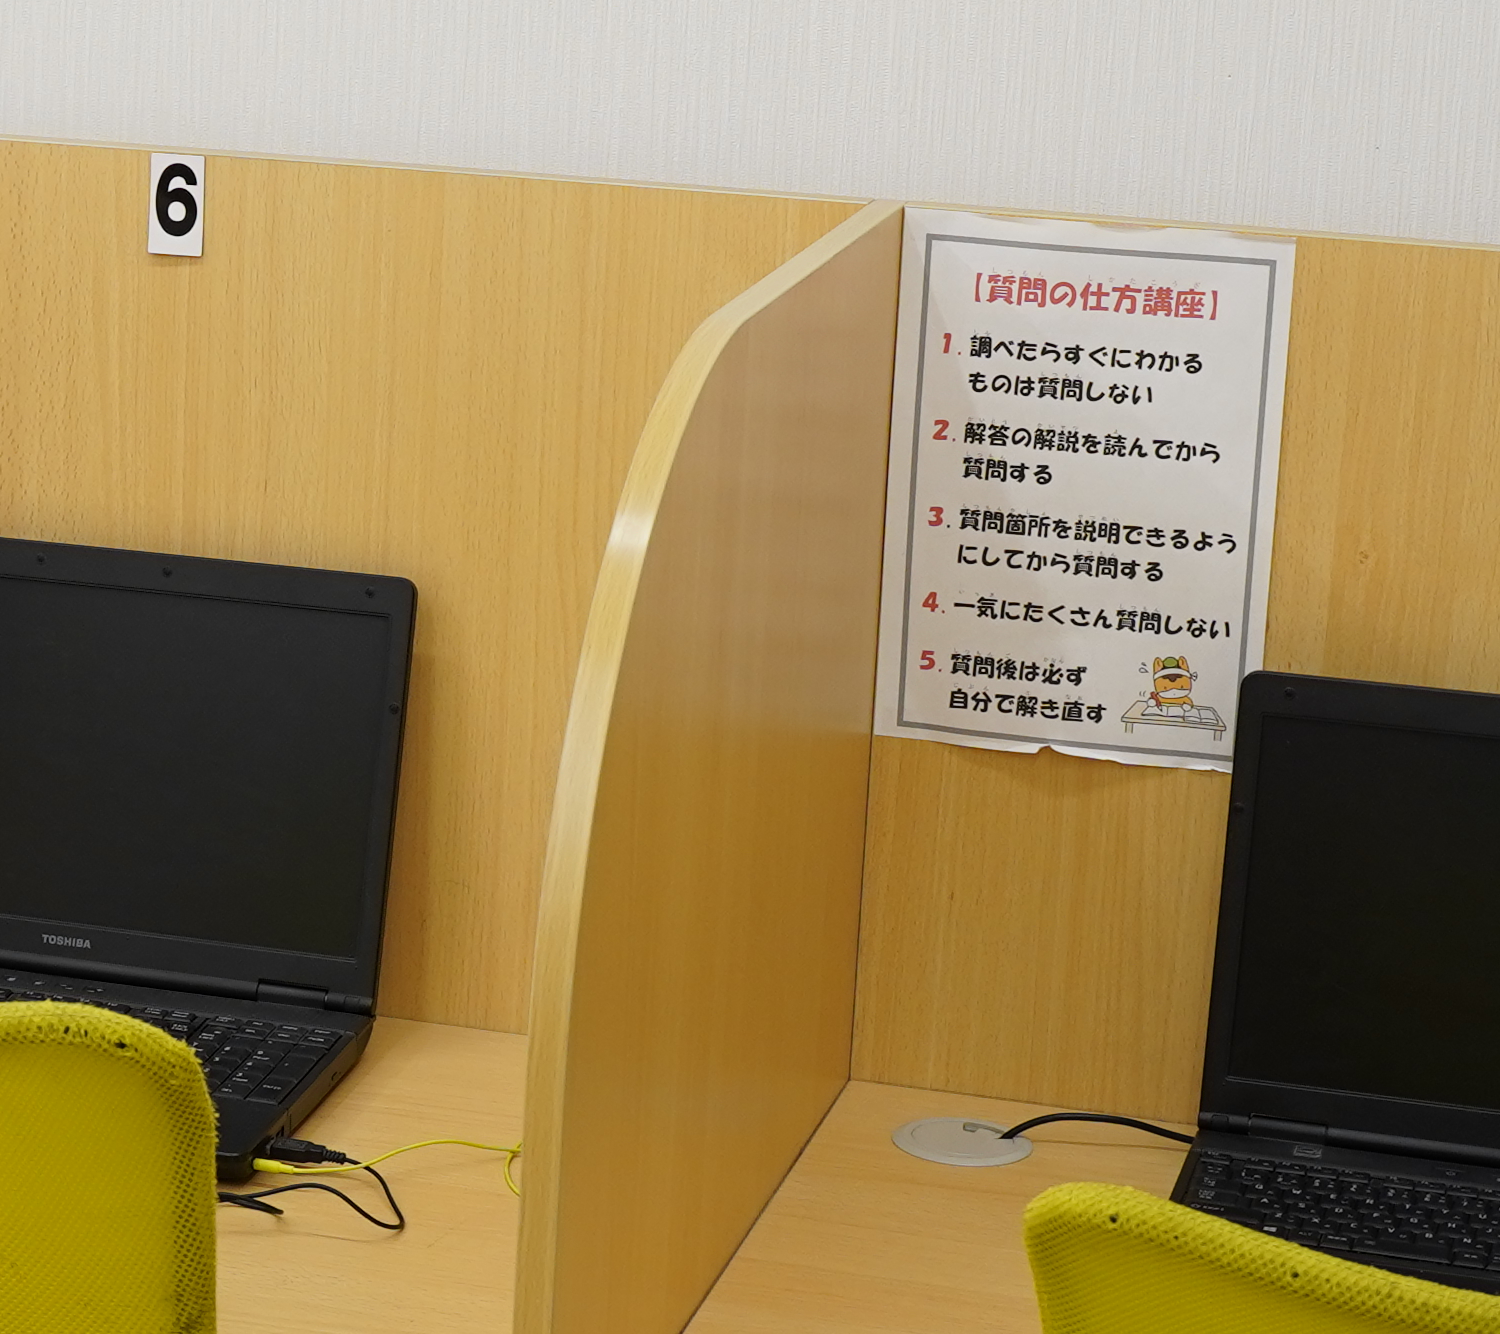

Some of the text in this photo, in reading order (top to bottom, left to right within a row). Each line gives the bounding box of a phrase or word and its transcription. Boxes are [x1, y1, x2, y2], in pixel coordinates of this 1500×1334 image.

[156, 163, 197, 237] 6
[974, 272, 1218, 320] 【質問の仕方講座】
[941, 333, 1203, 374] 1. 調べたらすぐにわかる
[968, 372, 1153, 405] ものは質問しない
[931, 419, 1221, 464] 2. 解答の解説を読んでから
[963, 457, 1053, 485] 質問する
[927, 506, 1237, 554] 3. 質問箇所を説明できるよう
[957, 544, 1164, 582] にしてから質問する
[922, 591, 1231, 639] 4. 一気にたくさん質問しない
[919, 650, 1087, 686] 5. 質問後は必ず
[949, 689, 1107, 724] 自分で解き直す
[42, 933, 91, 949] TOSHIBA
